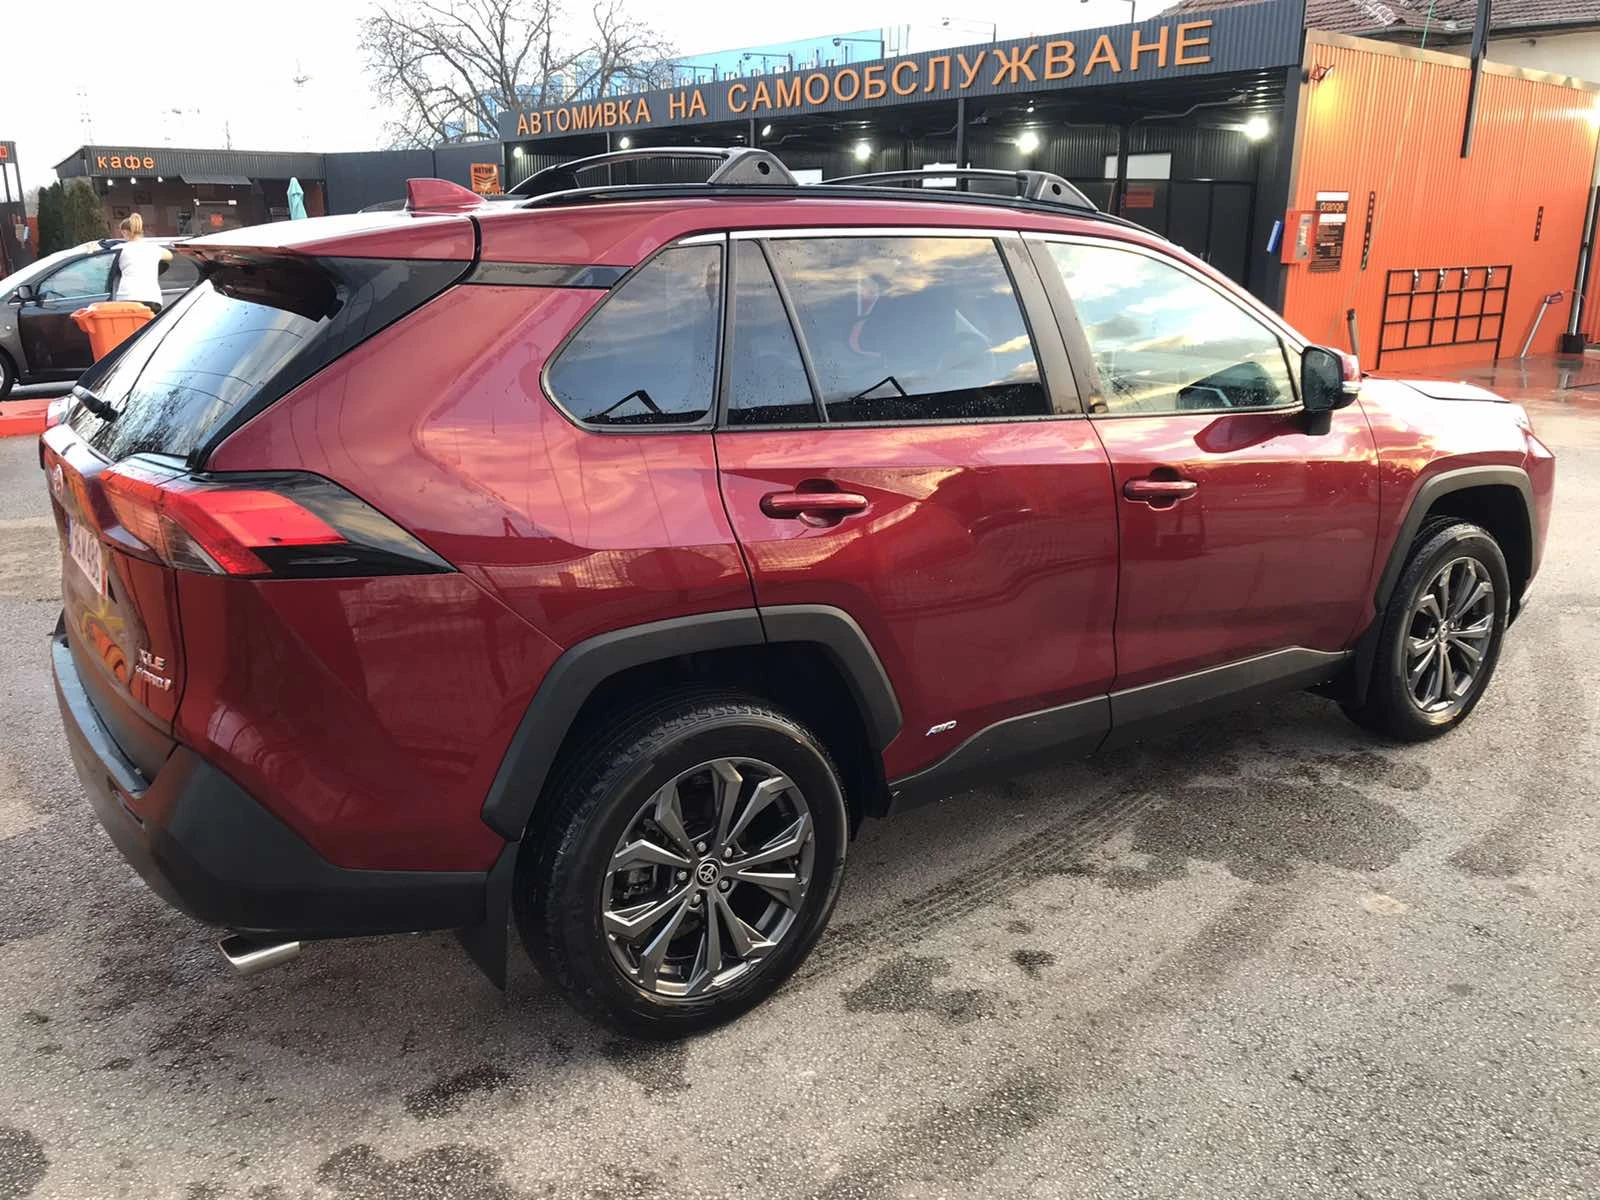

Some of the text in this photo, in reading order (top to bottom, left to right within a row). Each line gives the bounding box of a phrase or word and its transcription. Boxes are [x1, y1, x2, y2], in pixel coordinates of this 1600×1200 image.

[517, 20, 1213, 136] АВТОМИВКА НА САМООБСЛУЖВАНЕ
[97, 155, 155, 170] кафе
